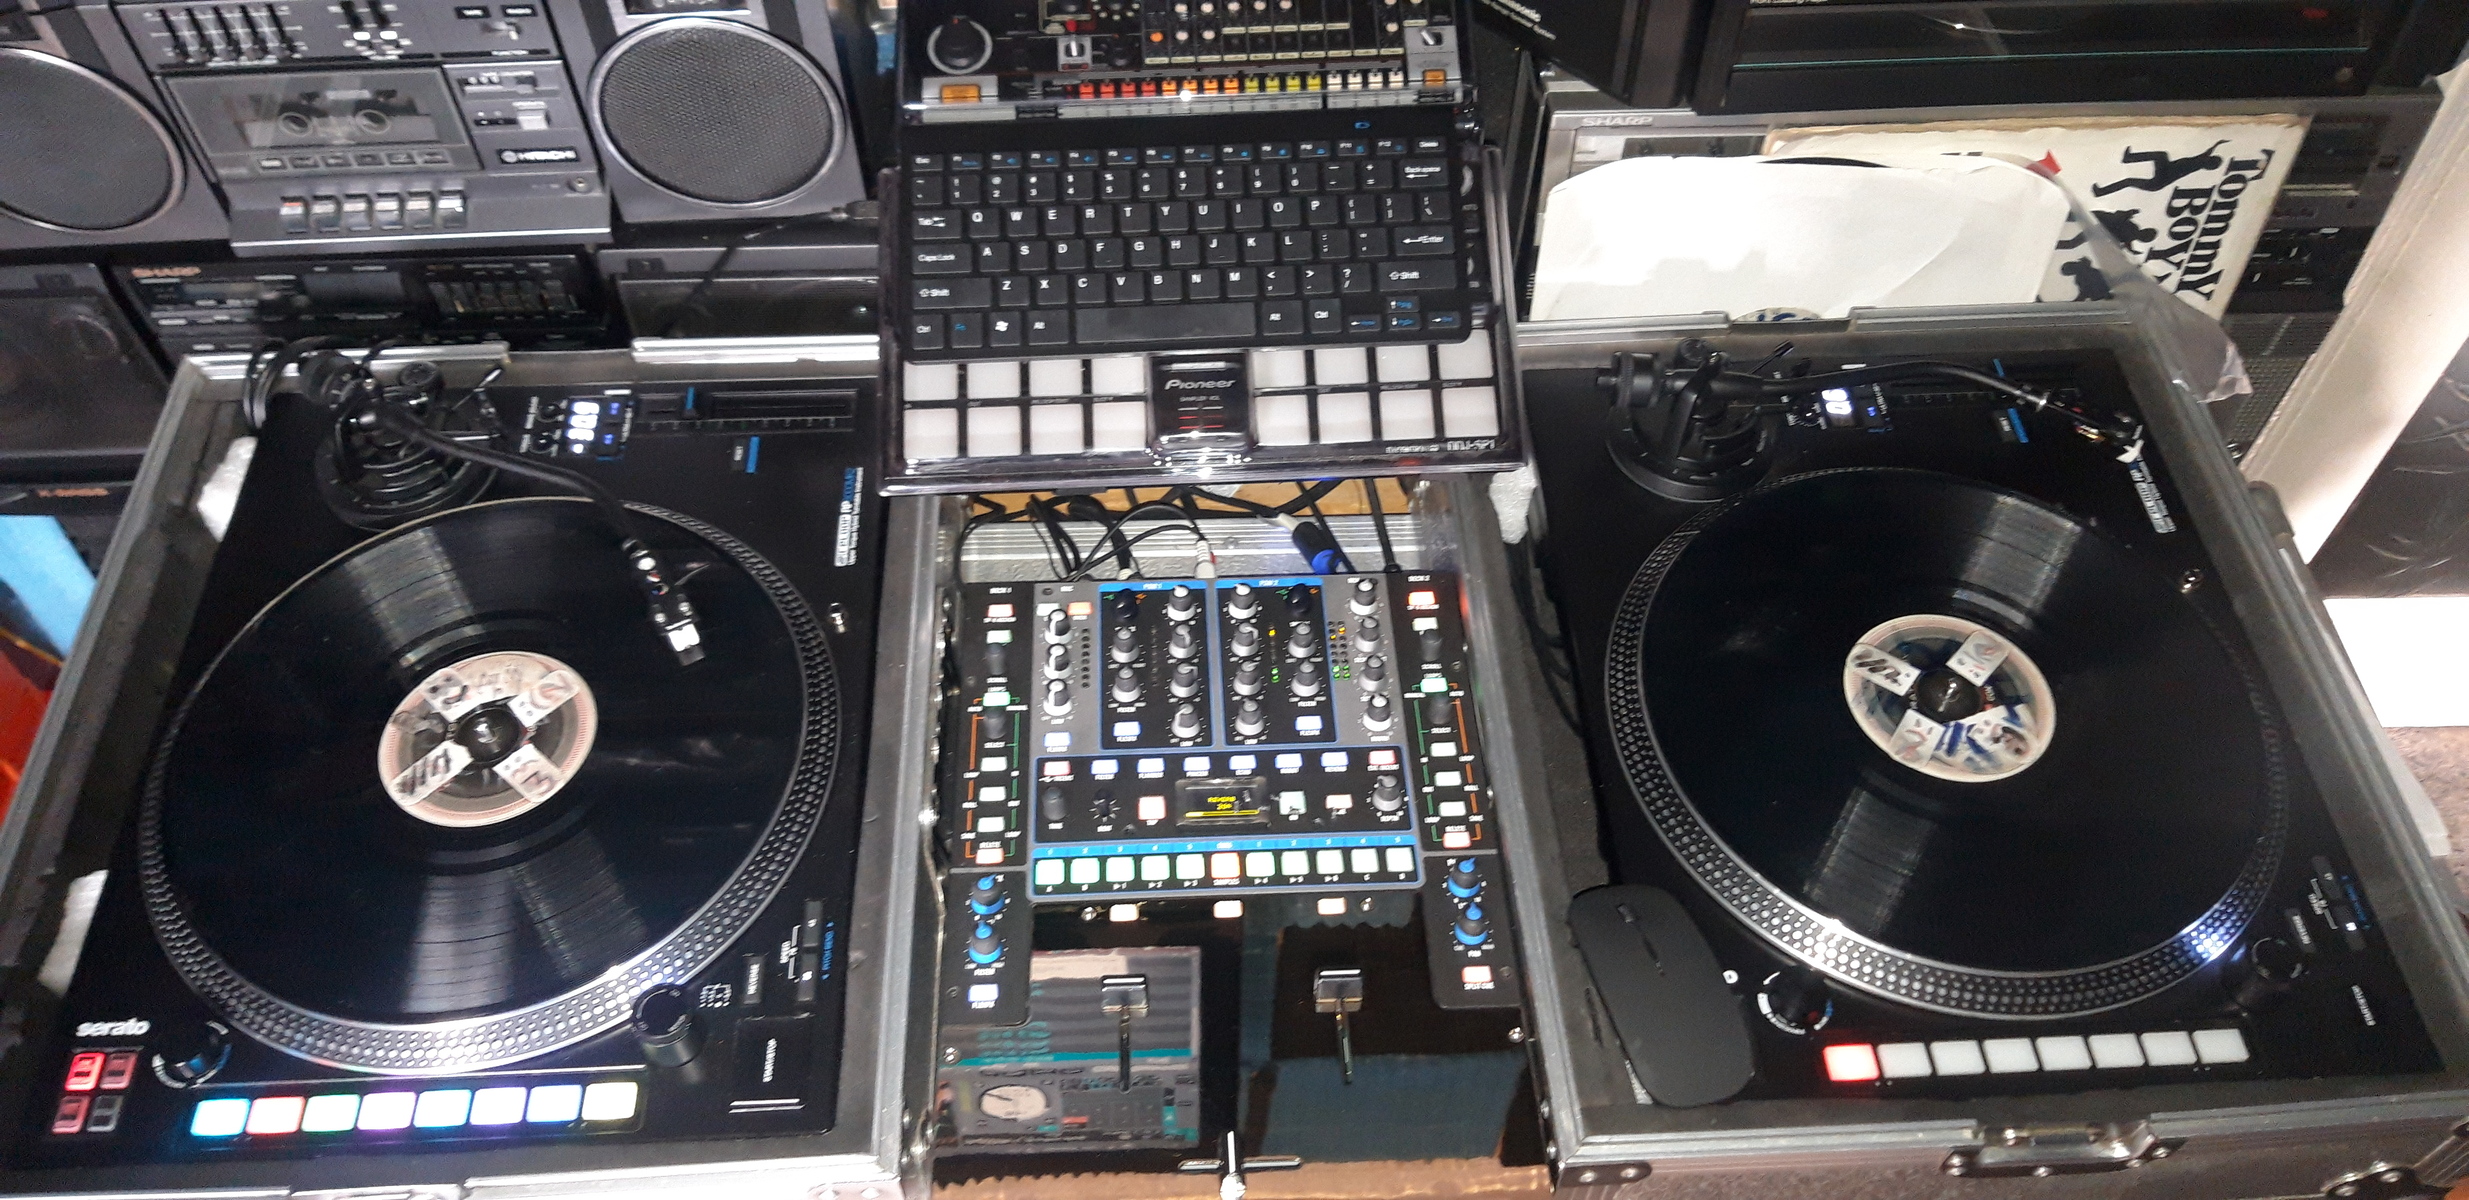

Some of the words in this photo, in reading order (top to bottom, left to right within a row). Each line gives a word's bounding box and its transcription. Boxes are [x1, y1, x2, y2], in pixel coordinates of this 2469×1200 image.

[1583, 117, 1652, 126] SHARP
[517, 150, 577, 160] HITACHI
[972, 212, 983, 222] Q
[1011, 212, 1022, 221] W
[1048, 210, 1057, 219] E
[1086, 209, 1094, 218] R
[1124, 207, 1132, 217] T
[1161, 206, 1170, 215] Y
[1199, 205, 1208, 215] U
[1236, 204, 1241, 213] I
[1273, 202, 1283, 212] O
[1311, 201, 1320, 210] P
[983, 247, 992, 256] A
[1020, 246, 1029, 255] S
[1058, 244, 1067, 253] D
[1096, 243, 1104, 251] F
[1134, 242, 1144, 250] G
[1171, 240, 1180, 249] H
[1210, 239, 1217, 248] J
[1247, 238, 1256, 246] K
[1285, 236, 1292, 244] L
[1003, 281, 1011, 290] Z
[1040, 280, 1049, 288] X
[1078, 278, 1087, 287] C
[1116, 277, 1125, 285] V
[1154, 275, 1163, 284] B
[1192, 274, 1201, 283] N
[1230, 272, 1240, 281] M
[1165, 379, 1235, 389] Pioneer
[747, 964, 759, 994] REVERSE
[76, 1018, 150, 1036] serato
